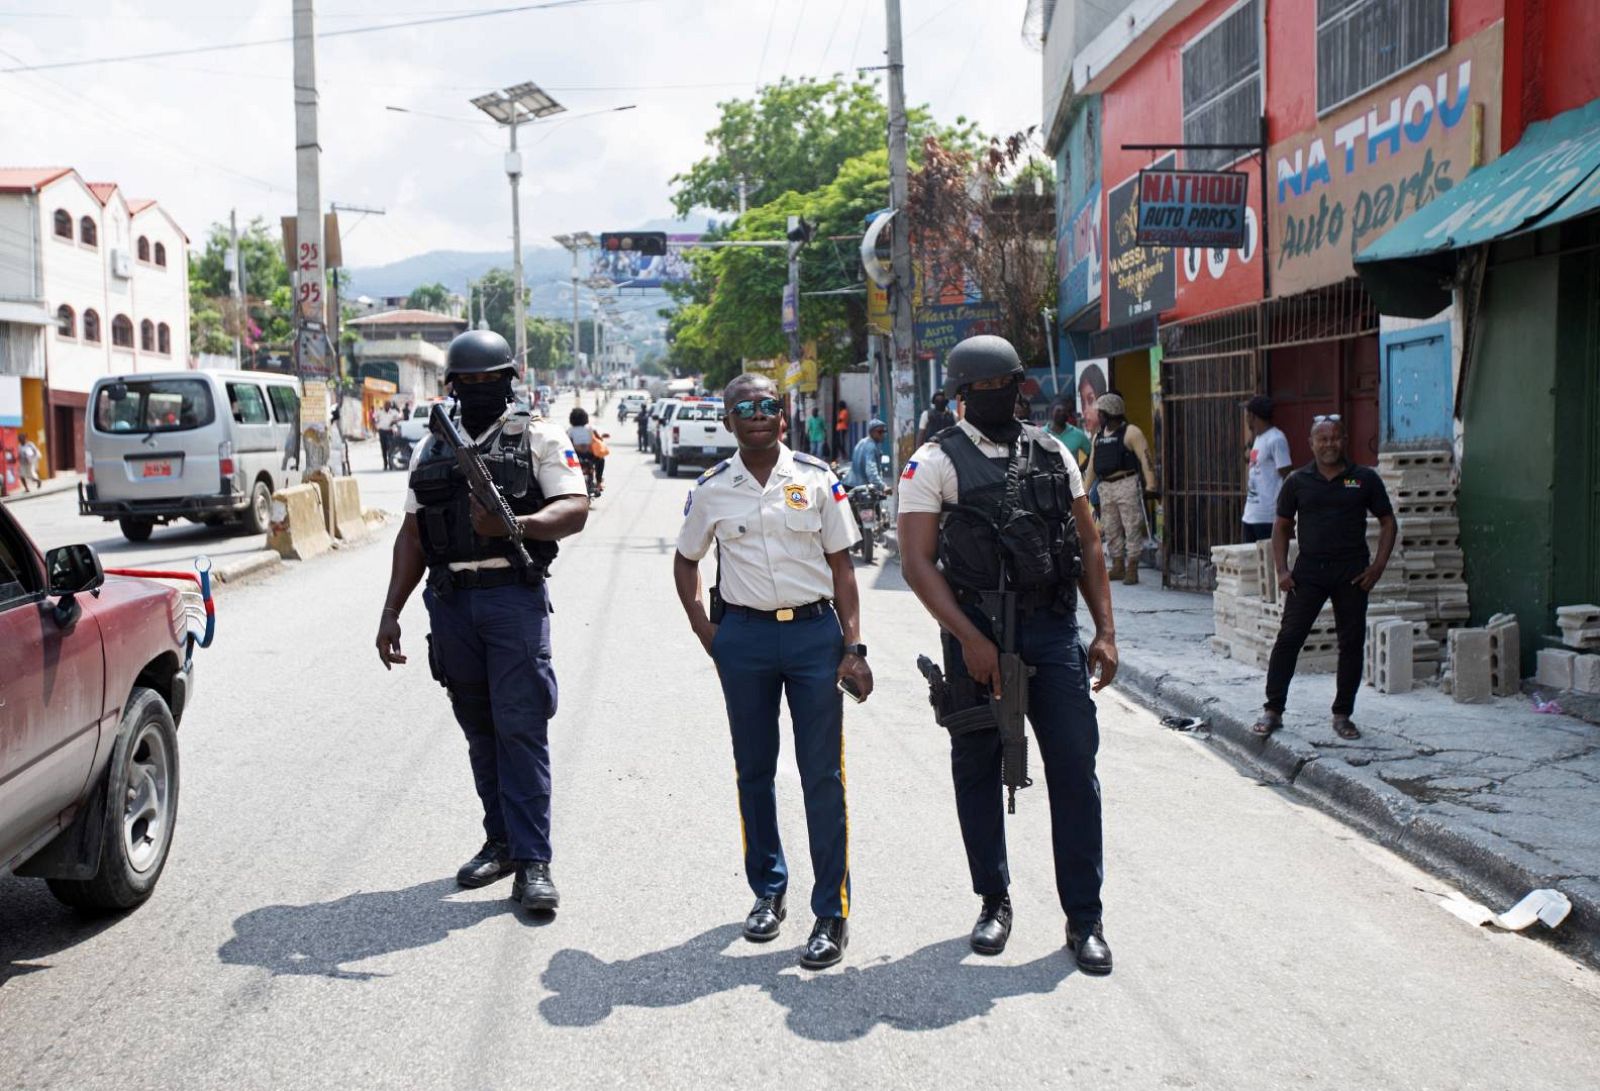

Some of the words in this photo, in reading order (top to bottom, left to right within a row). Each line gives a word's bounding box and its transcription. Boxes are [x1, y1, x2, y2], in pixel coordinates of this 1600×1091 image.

[1142, 174, 1242, 205] NATHOU
[1144, 206, 1184, 228] AUTO
[1187, 207, 1238, 229] PARTS
[1278, 192, 1345, 270] Auto
[1351, 147, 1454, 258] parts
[300, 282, 321, 302] 95
